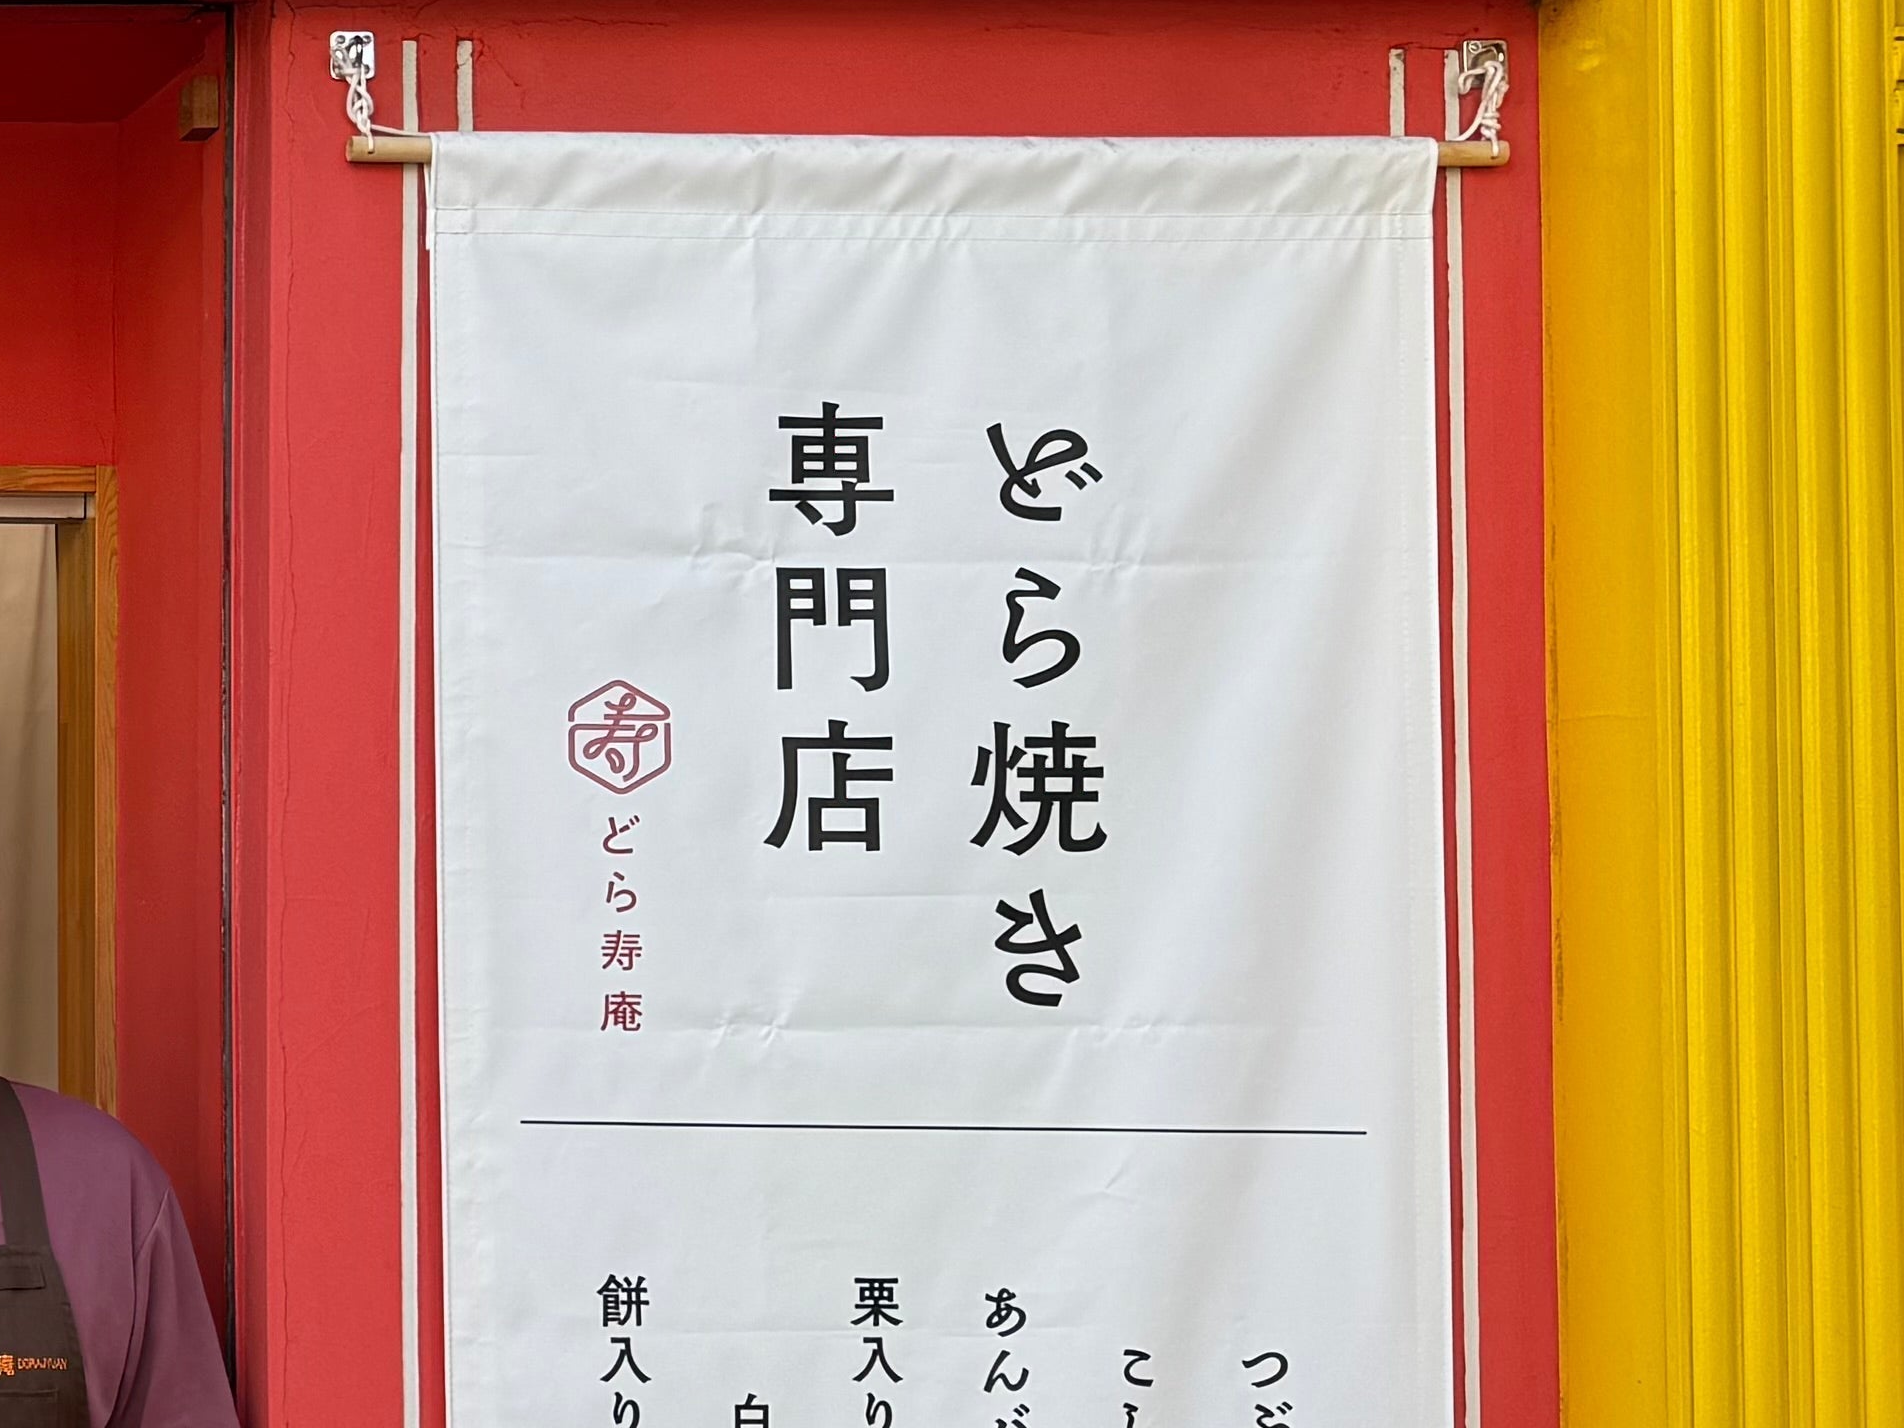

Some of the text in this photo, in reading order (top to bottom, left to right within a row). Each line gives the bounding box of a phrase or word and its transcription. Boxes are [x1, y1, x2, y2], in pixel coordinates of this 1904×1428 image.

[764, 402, 894, 851] 専門店
[970, 423, 1107, 1007] どら焼き
[600, 815, 642, 1031] どら寿庵
